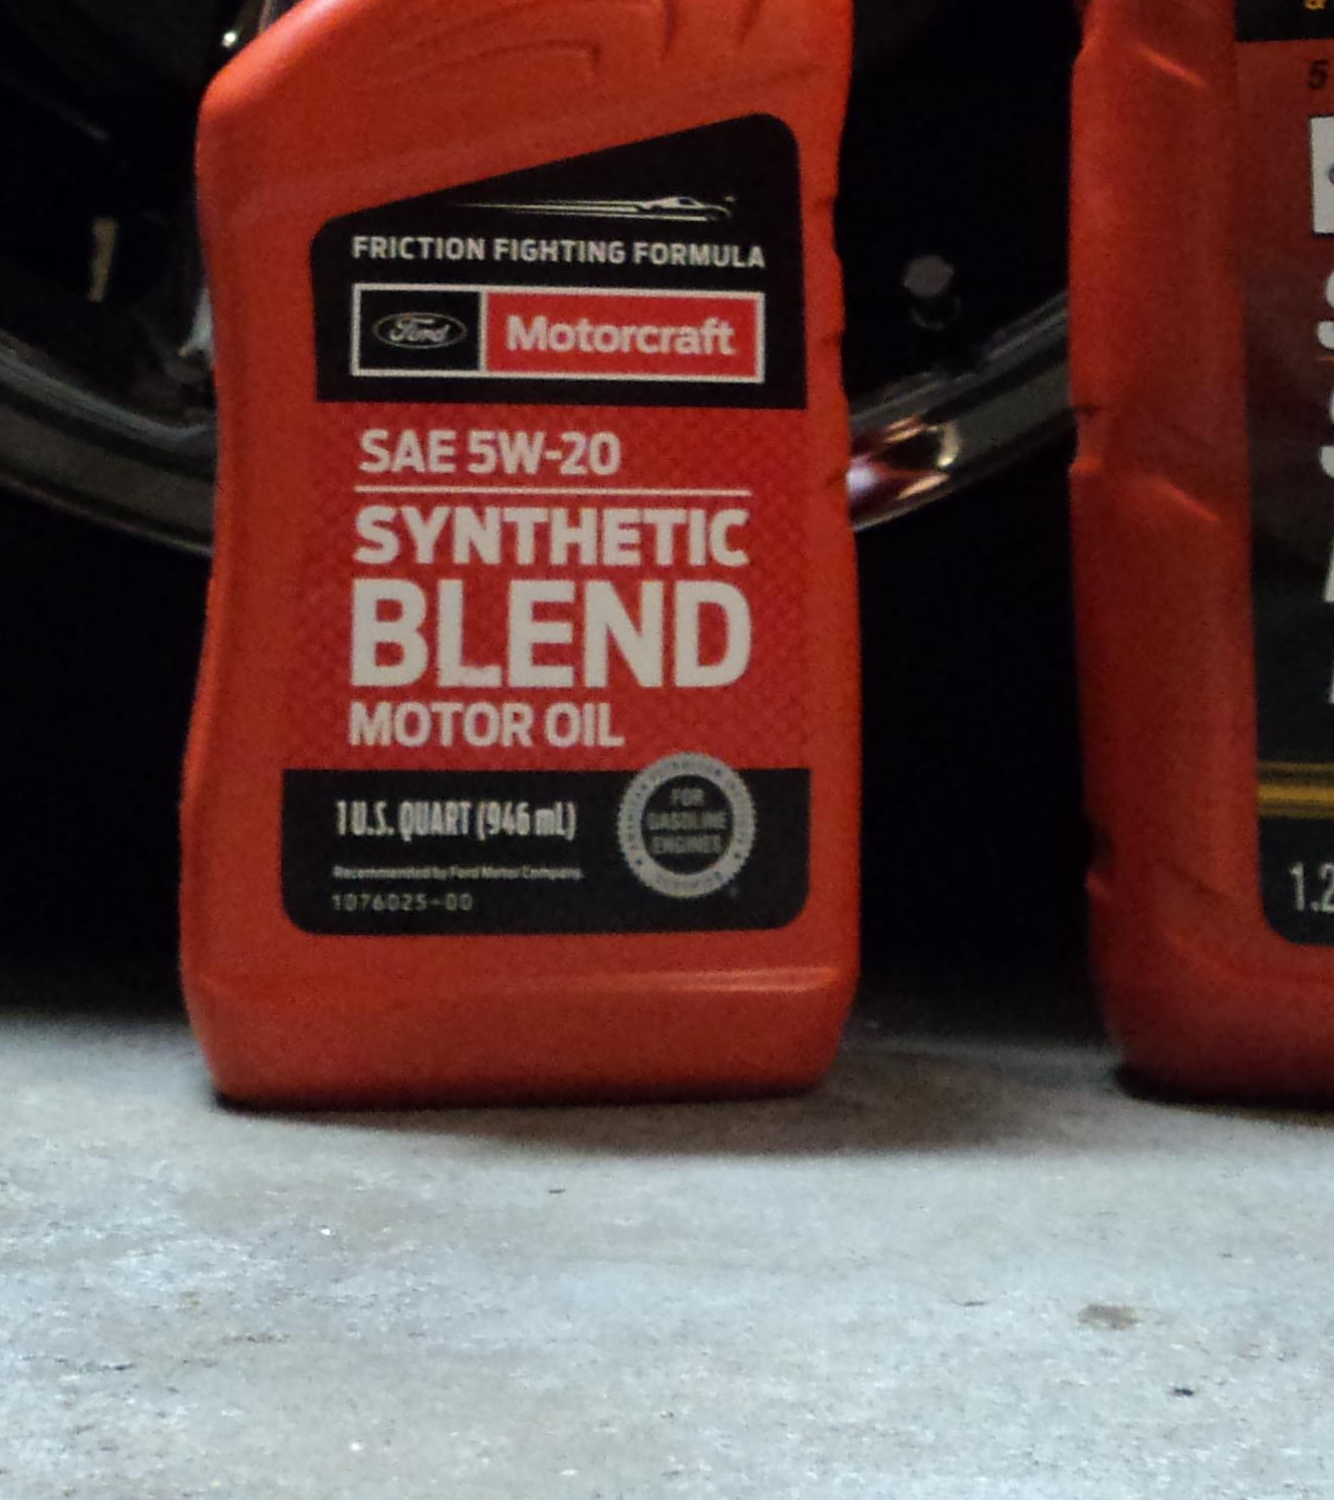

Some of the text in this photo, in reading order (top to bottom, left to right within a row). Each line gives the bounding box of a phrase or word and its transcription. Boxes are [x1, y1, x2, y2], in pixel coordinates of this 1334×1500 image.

[1309, 60, 1328, 90] 5
[352, 236, 765, 268] FRICTION FIGHTING FORMULA
[390, 316, 735, 355] Ford Motorcraft
[360, 429, 620, 474] SAE 5W-20
[354, 506, 750, 566] SYNTHETIC
[351, 578, 751, 688] BLEND
[349, 702, 624, 746] MOTOR OIL
[337, 802, 347, 835] 1
[352, 802, 394, 835] U.S.
[399, 801, 472, 841] QUART
[476, 801, 531, 841] (946
